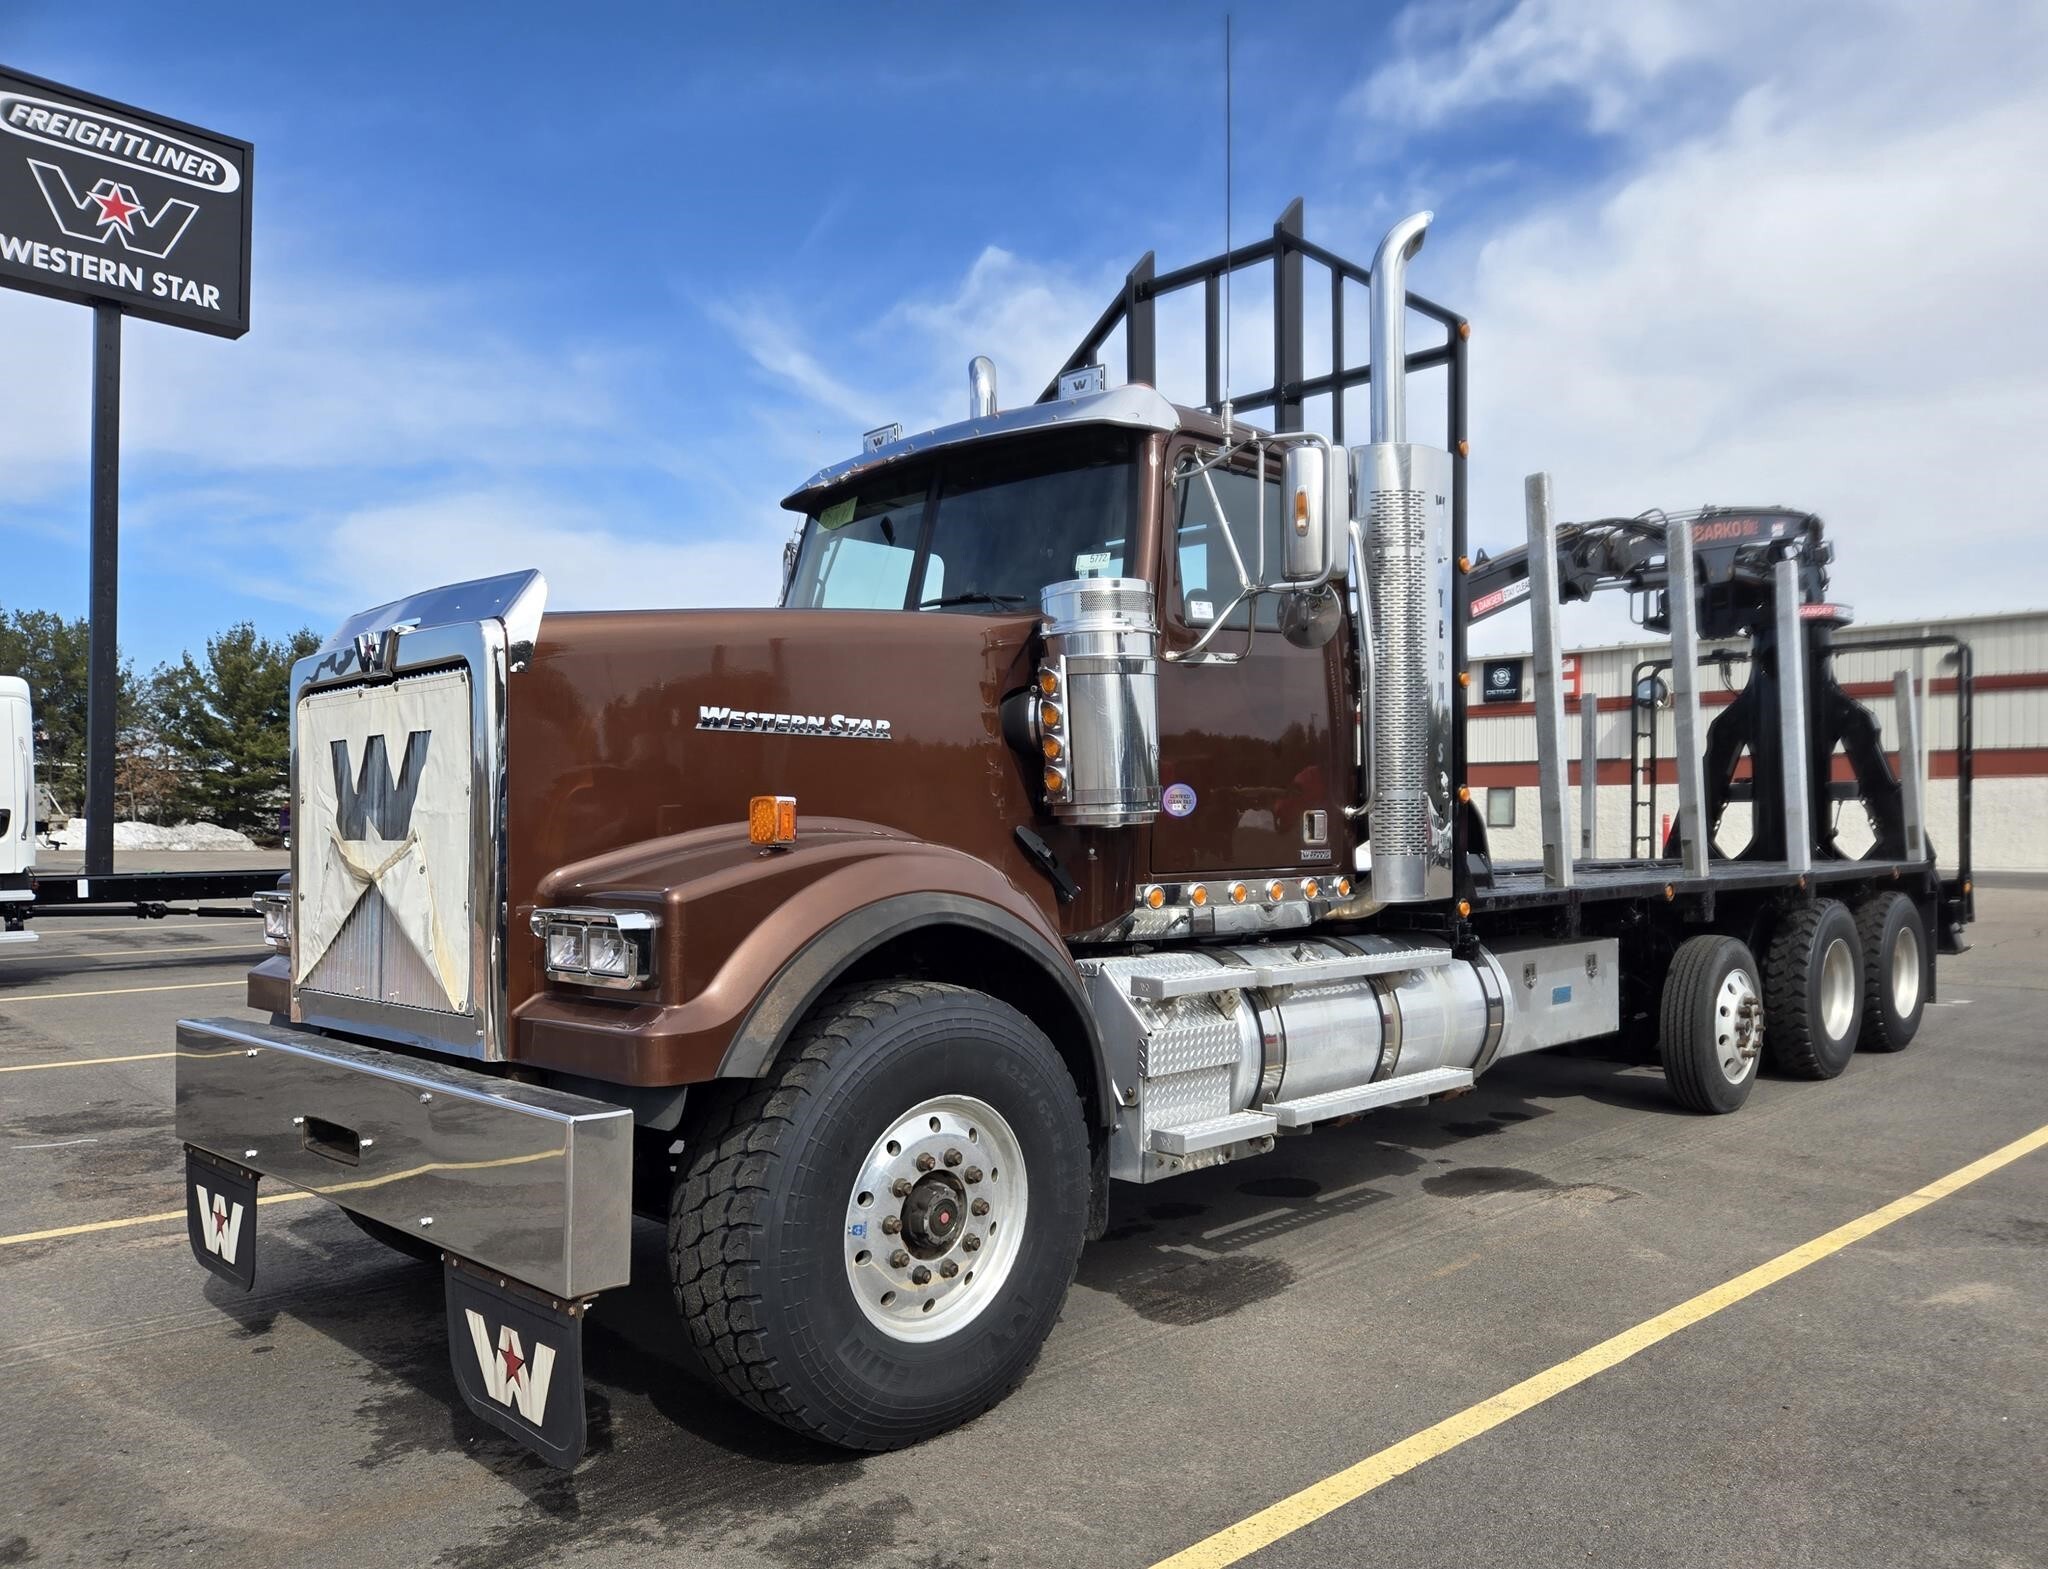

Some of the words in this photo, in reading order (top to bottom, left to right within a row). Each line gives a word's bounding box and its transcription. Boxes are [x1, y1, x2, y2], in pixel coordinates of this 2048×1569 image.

[8, 103, 217, 181] FREIGHTLINER
[0, 233, 143, 292] WESTERN
[152, 271, 220, 311] STAR
[1486, 688, 1517, 696] DETROIT
[700, 706, 826, 734] WESTERN
[829, 714, 892, 738] STAR
